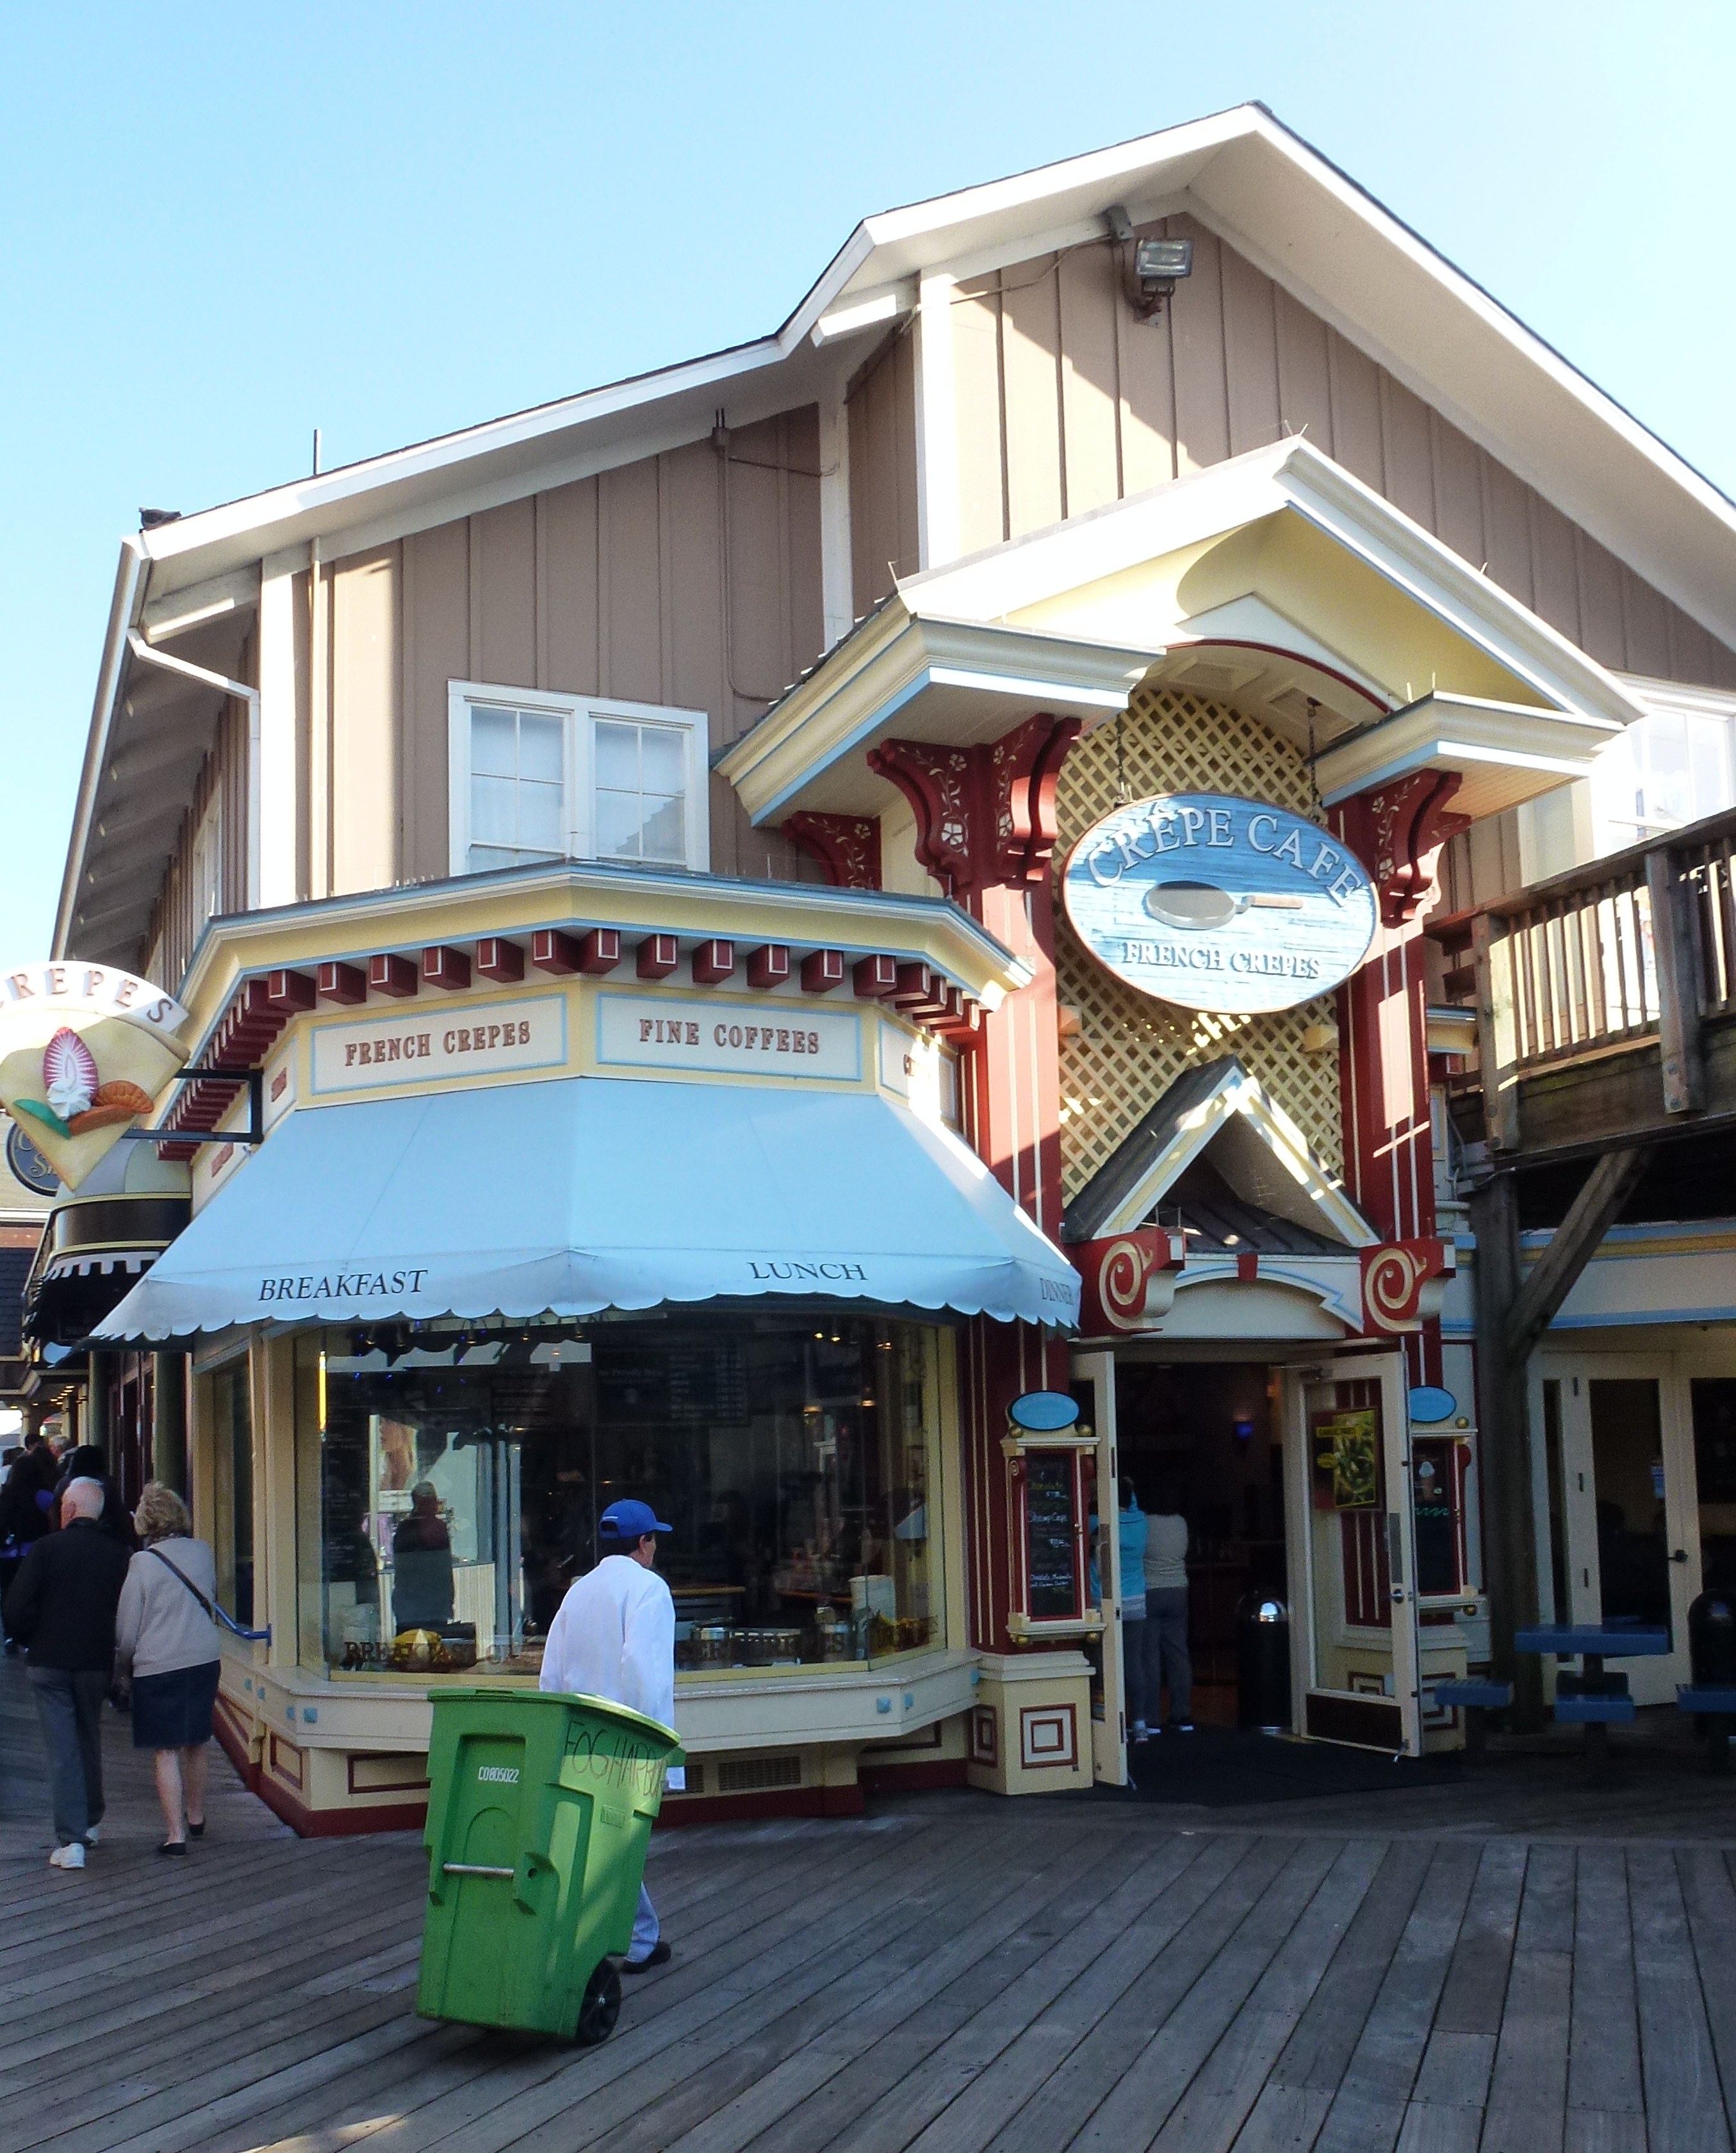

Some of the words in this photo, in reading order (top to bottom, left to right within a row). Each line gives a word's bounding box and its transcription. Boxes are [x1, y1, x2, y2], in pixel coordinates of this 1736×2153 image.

[1248, 814, 1363, 907] CAFE
[1121, 942, 1225, 970] FRENCH
[1230, 951, 1320, 979] CREPES
[0, 969, 172, 1023] REPES
[345, 1033, 431, 1067] FRENCH
[443, 1020, 531, 1054] CREPES
[639, 1019, 700, 1045] FINE
[714, 1024, 819, 1054] COFFEES
[258, 1269, 429, 1301] BREAKFAST
[746, 1262, 869, 1281] LUNCH
[1039, 1277, 1075, 1306] DINNER
